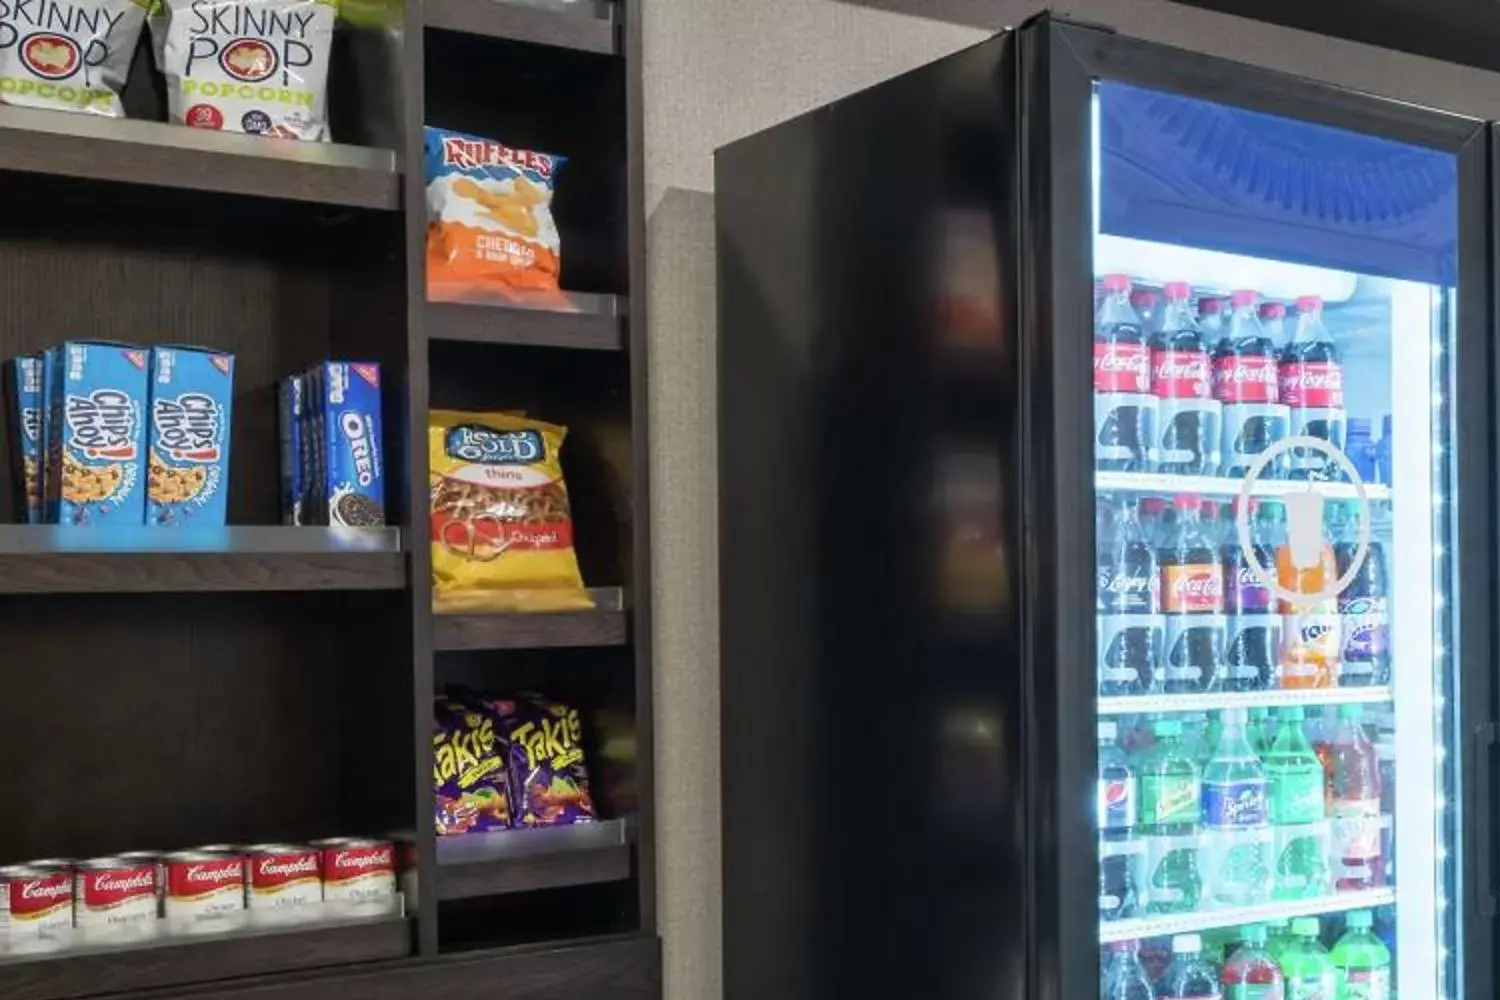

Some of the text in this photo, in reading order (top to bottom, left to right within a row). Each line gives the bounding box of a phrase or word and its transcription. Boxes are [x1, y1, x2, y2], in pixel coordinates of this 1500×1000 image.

[190, 0, 315, 38] SKINNY
[185, 37, 312, 86] POP
[181, 80, 314, 105] POPCORN
[446, 139, 551, 178] RUFFLES
[92, 391, 131, 447] Chips
[180, 395, 217, 450] Chips
[340, 410, 372, 487] OREO
[511, 708, 582, 771] Takis
